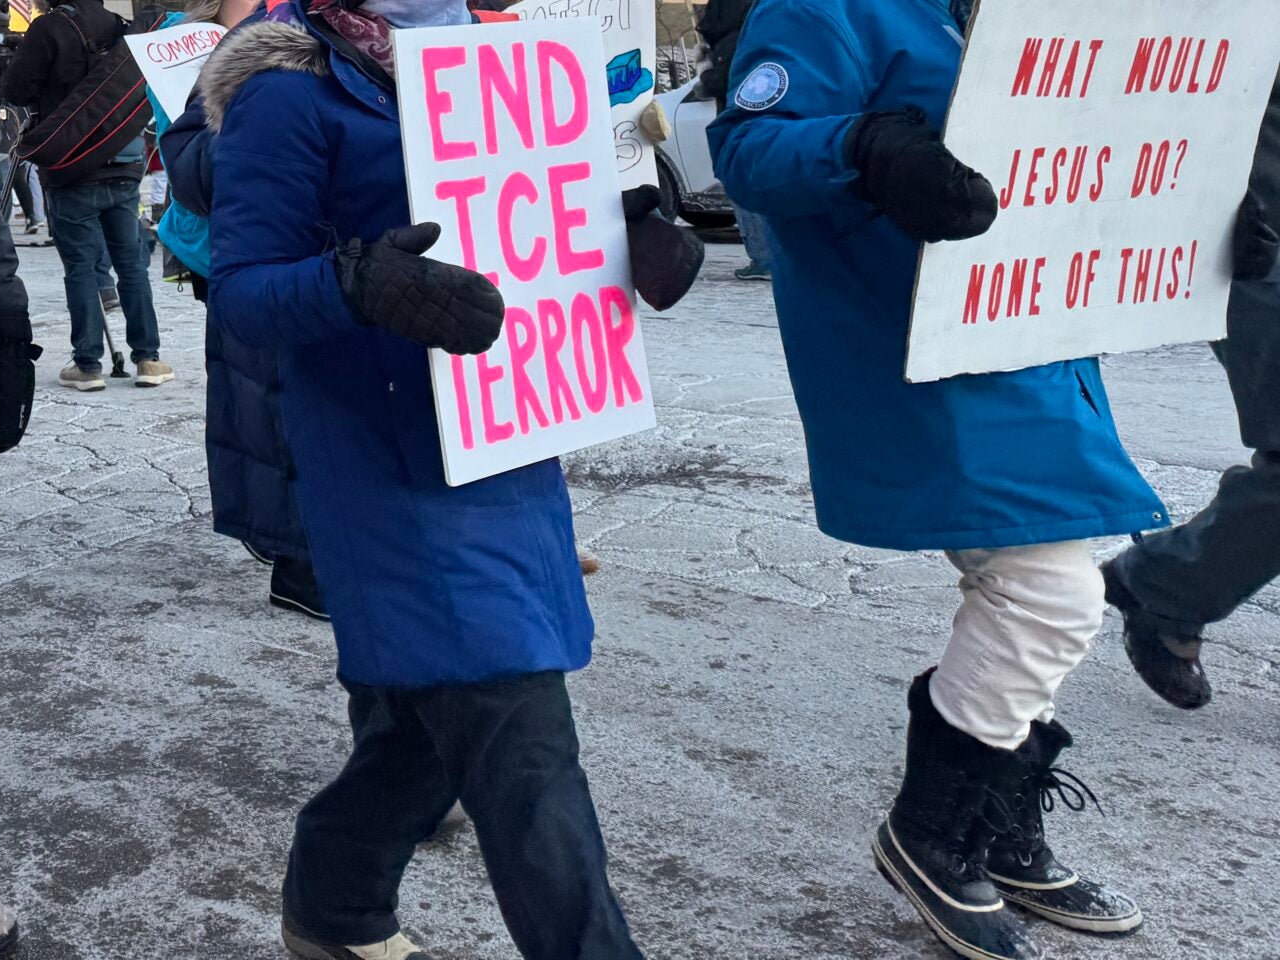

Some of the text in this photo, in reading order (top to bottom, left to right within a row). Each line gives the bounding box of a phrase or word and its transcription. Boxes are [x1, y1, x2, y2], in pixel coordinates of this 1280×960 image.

[421, 40, 590, 163] END
[1011, 37, 1230, 98] WHAT WOULD
[999, 139, 1188, 210] JESUS DO?
[434, 161, 605, 288] ICE
[961, 240, 1198, 325] NONE OF THIS!
